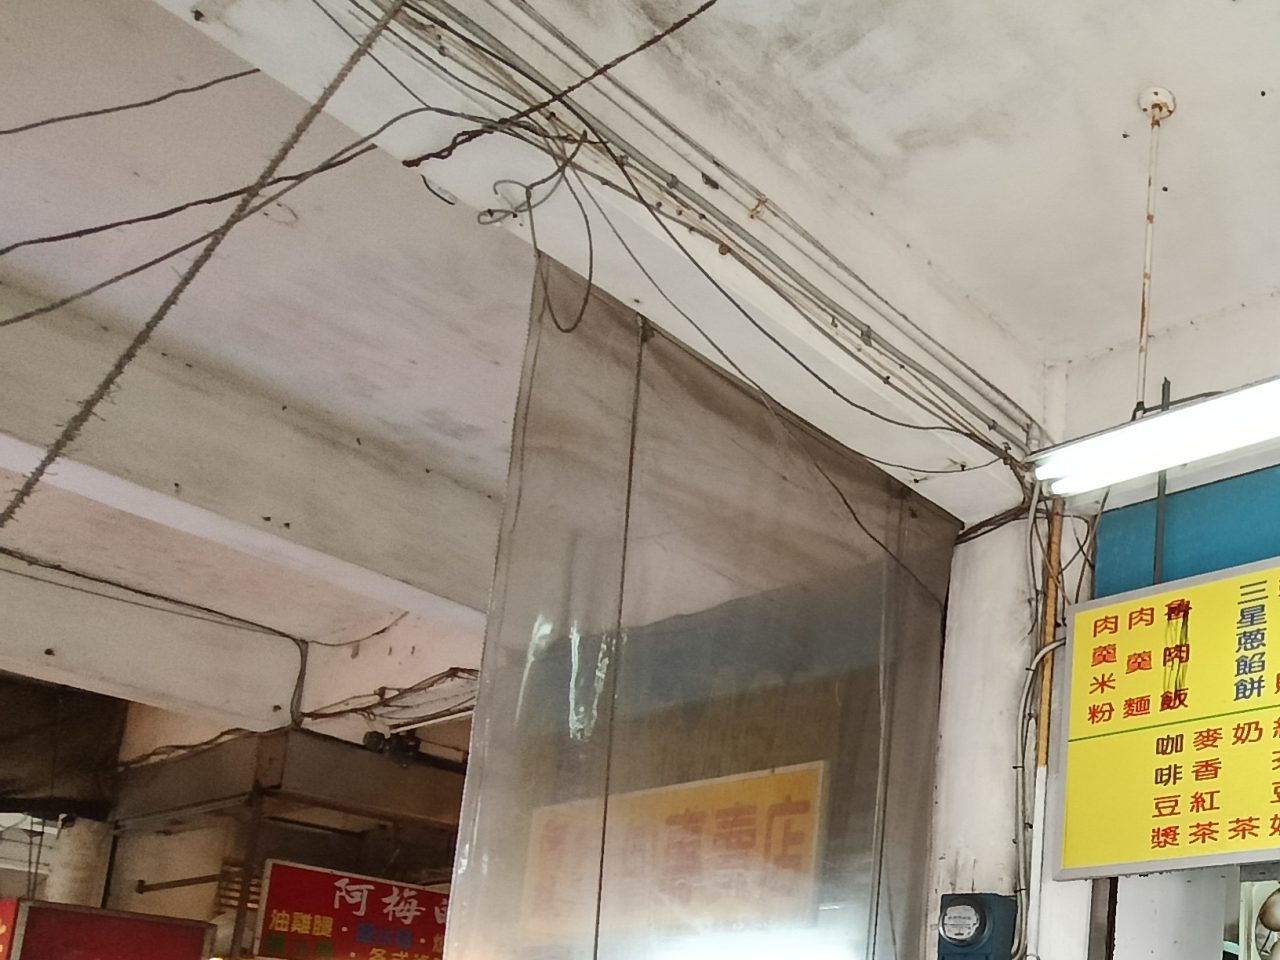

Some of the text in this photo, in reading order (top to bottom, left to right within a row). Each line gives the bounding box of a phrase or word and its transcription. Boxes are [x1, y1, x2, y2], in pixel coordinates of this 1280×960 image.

[1150, 734, 1185, 849] 咖啡豆漿
[1188, 729, 1225, 845] 麥香紅茶
[1227, 722, 1264, 840] 奶茶
